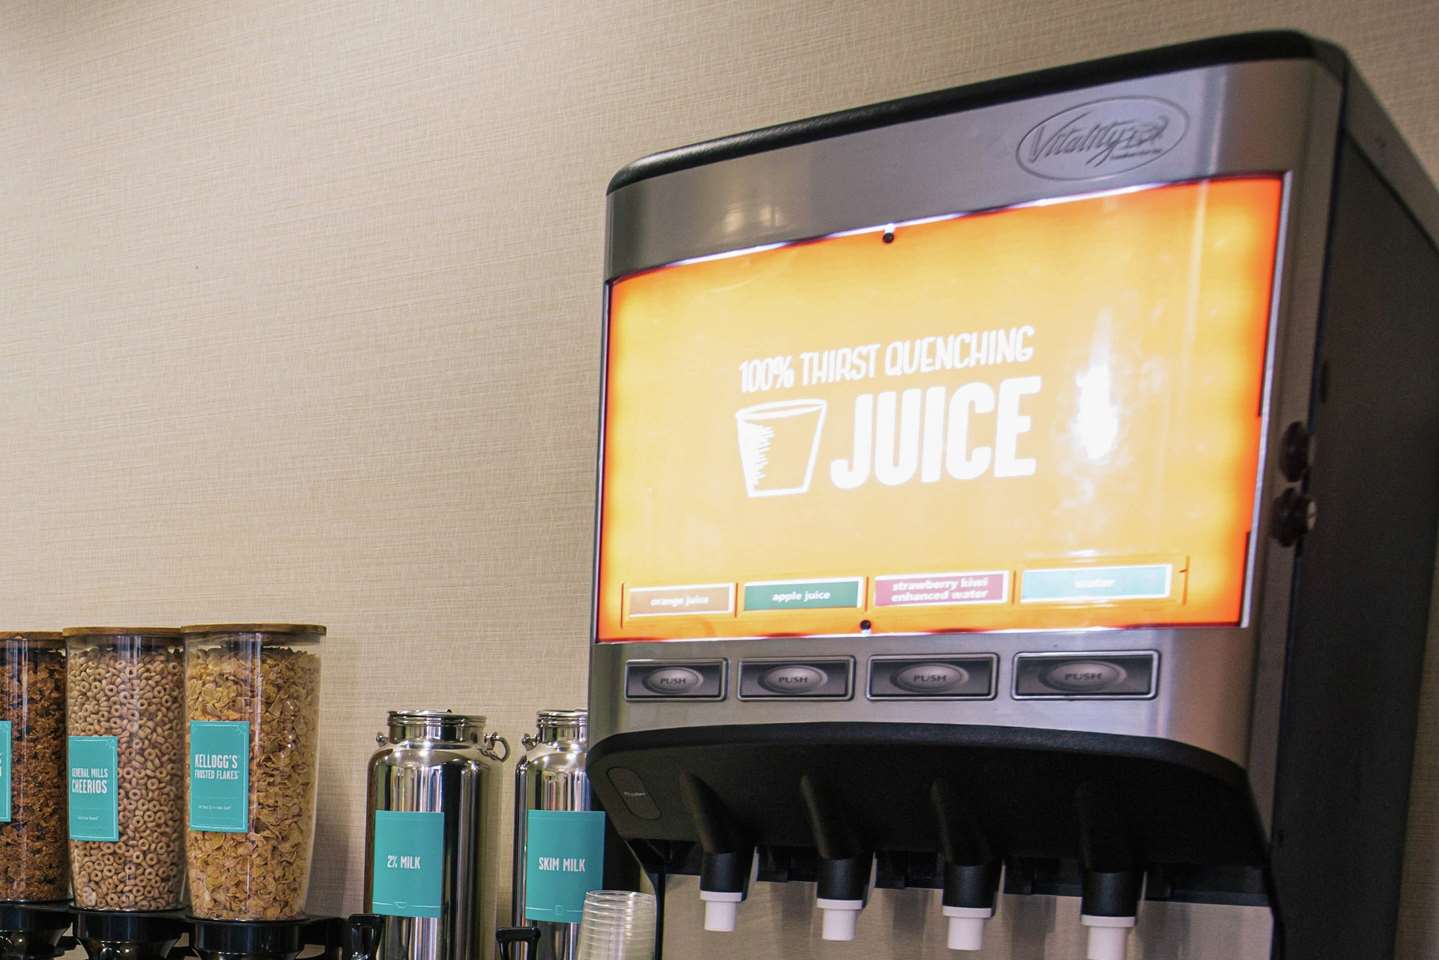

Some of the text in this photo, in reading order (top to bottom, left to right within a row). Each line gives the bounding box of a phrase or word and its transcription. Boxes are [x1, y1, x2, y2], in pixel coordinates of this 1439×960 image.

[738, 325, 1036, 393] 100% THIRST QUENCHING
[830, 375, 1043, 490] JUICE
[892, 577, 989, 593] strawberry kiwi
[772, 590, 831, 604] apple juice
[891, 588, 989, 602] enhanced water
[660, 677, 687, 685] PUSH
[778, 676, 809, 684] PUSH
[913, 674, 948, 683] PUSH
[1063, 672, 1103, 681] PUSH
[195, 753, 238, 769] KELLOGG'S
[91, 768, 109, 779] MILLS
[216, 769, 238, 780] FLAKES
[72, 779, 108, 794] CHEERIOS
[386, 855, 421, 870] 2% MILK
[538, 857, 586, 873] SKIM MILK
